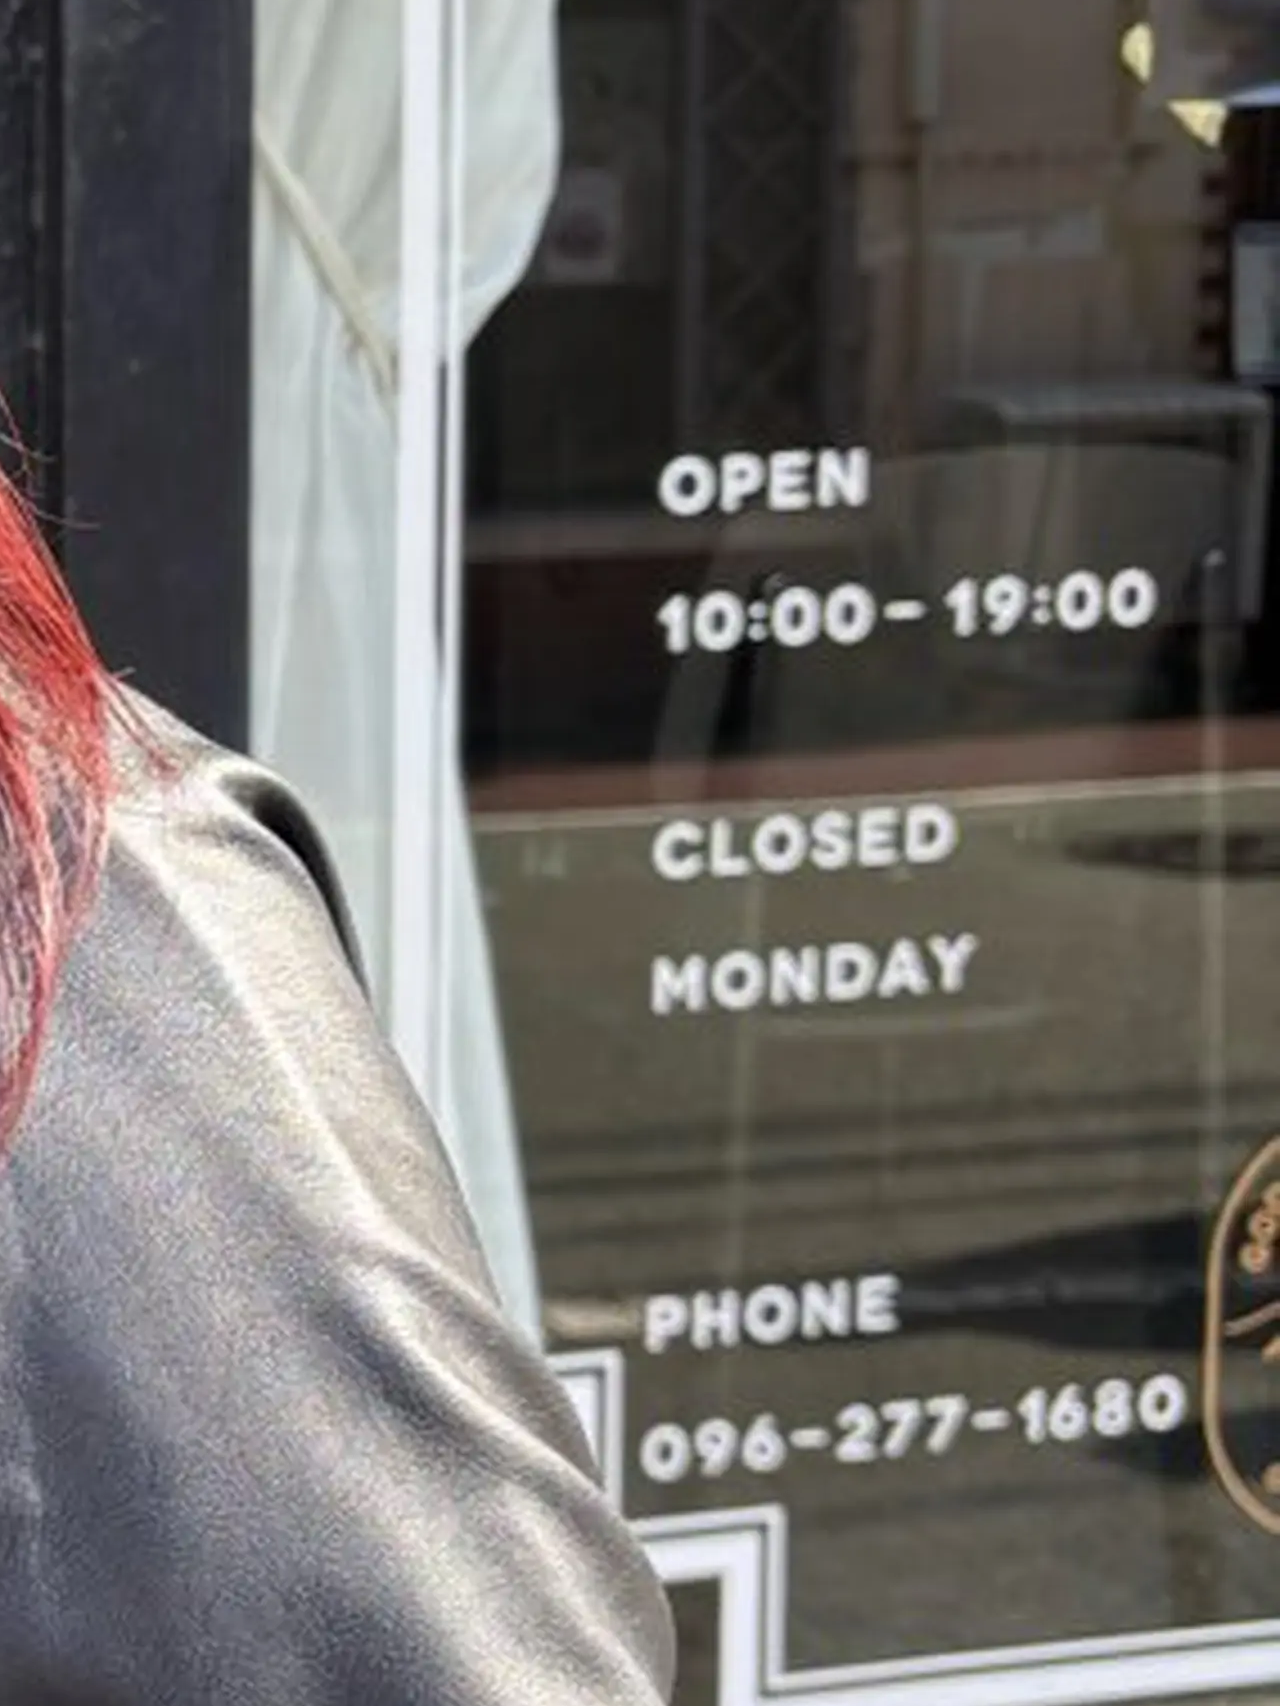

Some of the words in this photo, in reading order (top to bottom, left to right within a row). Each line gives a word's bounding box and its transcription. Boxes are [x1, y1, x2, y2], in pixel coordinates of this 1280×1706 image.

[657, 446, 870, 517] OPEN
[651, 802, 958, 881] CLOSED
[650, 932, 978, 1015] MONDAY
[643, 1273, 899, 1355] PHONE
[639, 1372, 1188, 1484] 096-277-1680
